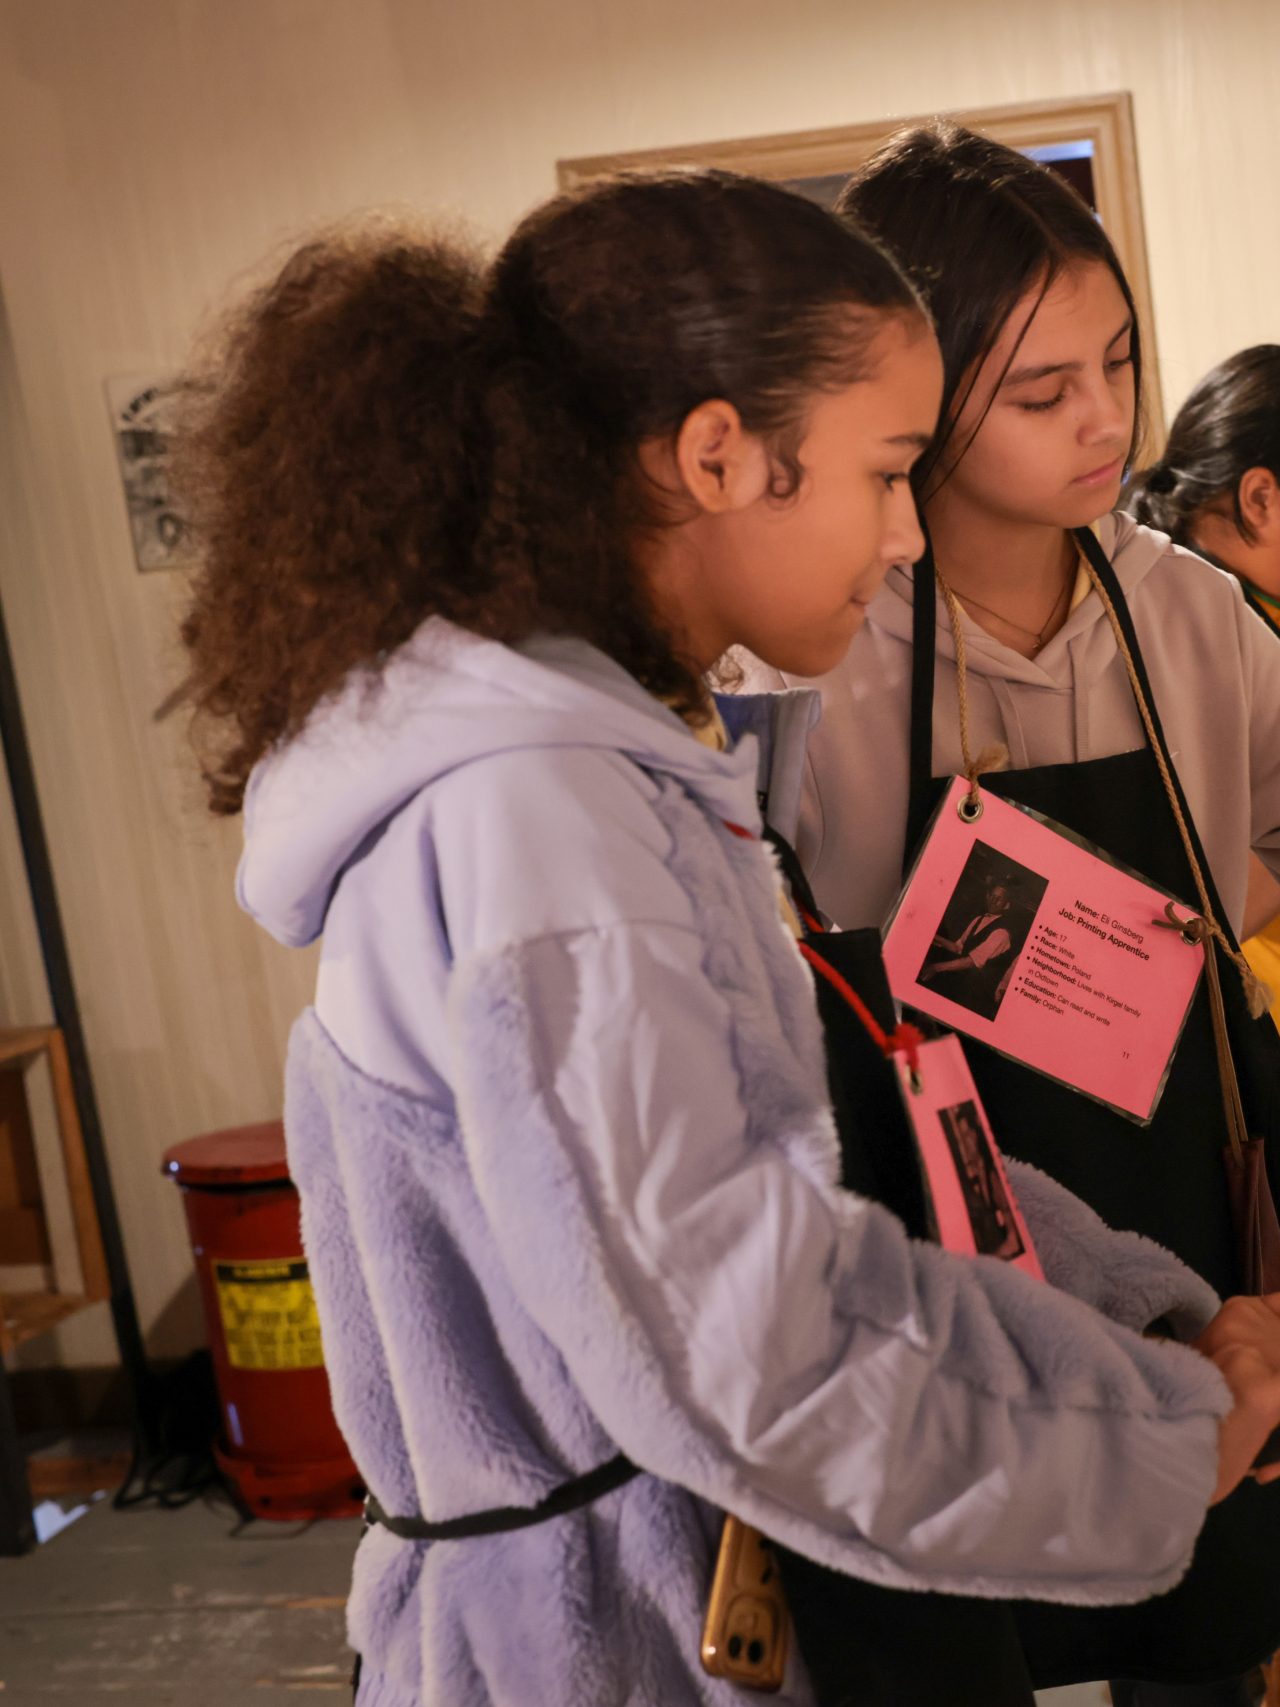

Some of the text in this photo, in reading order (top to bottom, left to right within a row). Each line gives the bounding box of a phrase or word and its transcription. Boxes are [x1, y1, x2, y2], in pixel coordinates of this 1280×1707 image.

[1043, 926, 1068, 943] Age: 17
[1058, 907, 1150, 961] Job: Printing Apprentice
[1074, 899, 1144, 945] Name: Eli Ginsberg
[1035, 946, 1093, 981] Hometown: Poland
[1039, 936, 1076, 961] Race: White
[1031, 956, 1077, 985] Neighborhood:
[1076, 980, 1093, 994] Lives
[1092, 989, 1106, 1000] with
[1122, 1003, 1142, 1019] family
[1034, 970, 1059, 989] Oldtown
[1019, 987, 1065, 1016] Family: Orphan
[1023, 977, 1111, 1027] Education: Can read and write
[1122, 1051, 1130, 1060] 11
